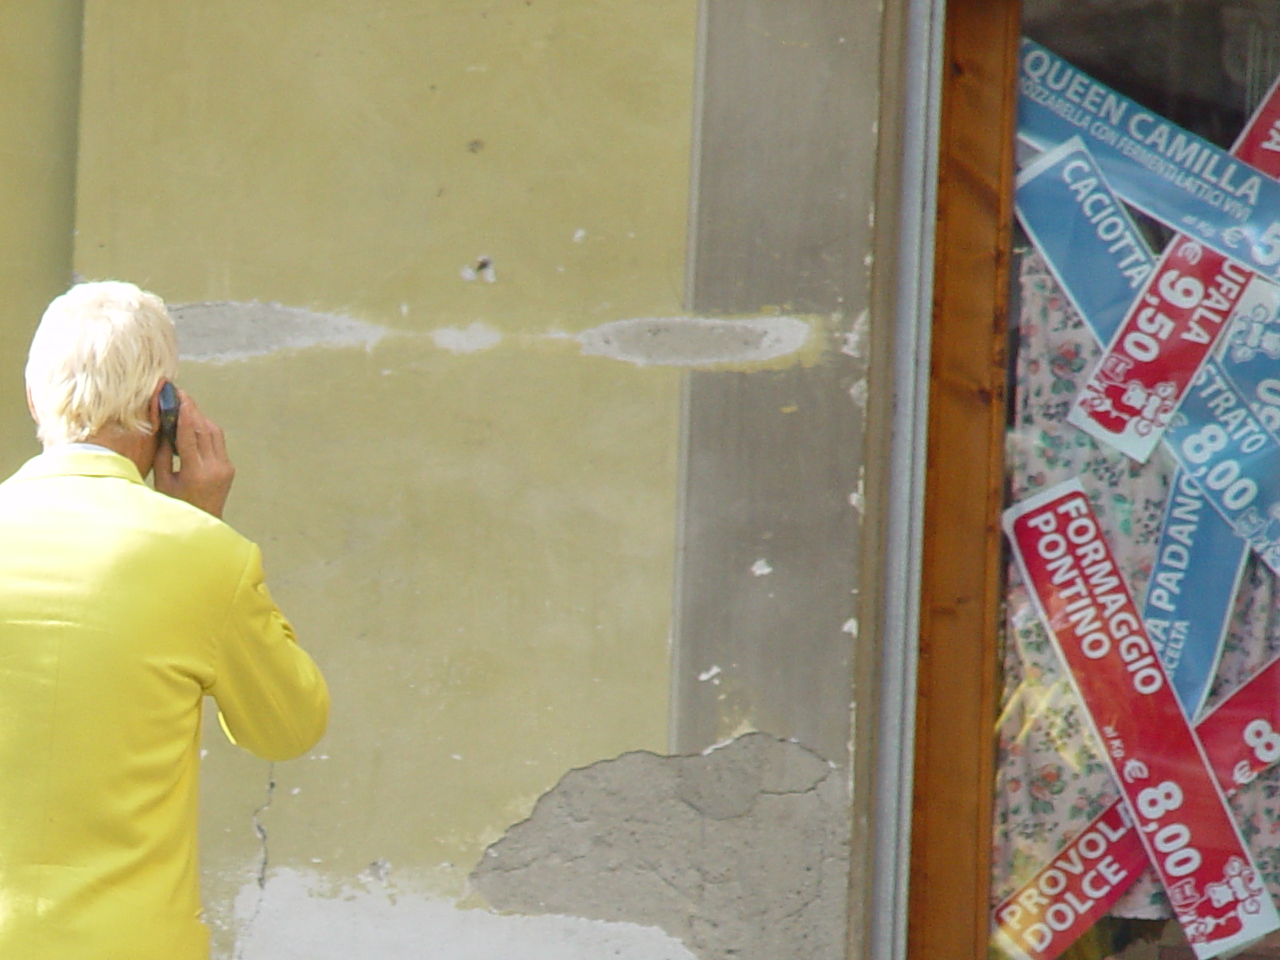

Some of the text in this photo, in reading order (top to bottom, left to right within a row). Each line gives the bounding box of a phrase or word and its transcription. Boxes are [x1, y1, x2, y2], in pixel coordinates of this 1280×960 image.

[1020, 78, 1092, 130] OZZARELLA
[1023, 50, 1129, 126] QUEEN
[1128, 113, 1261, 205] CAMILLA
[1061, 160, 1153, 289] CACIOTTA
[1123, 270, 1204, 363] 9,50
[1181, 258, 1247, 345] UFALA
[1195, 363, 1267, 454] STRATO
[1181, 424, 1258, 511] 8,00
[1027, 512, 1111, 659] PONTINO
[1057, 497, 1163, 695] FORMAGGIO
[1136, 781, 1202, 878] 8,00
[1022, 856, 1128, 953] DOLCE
